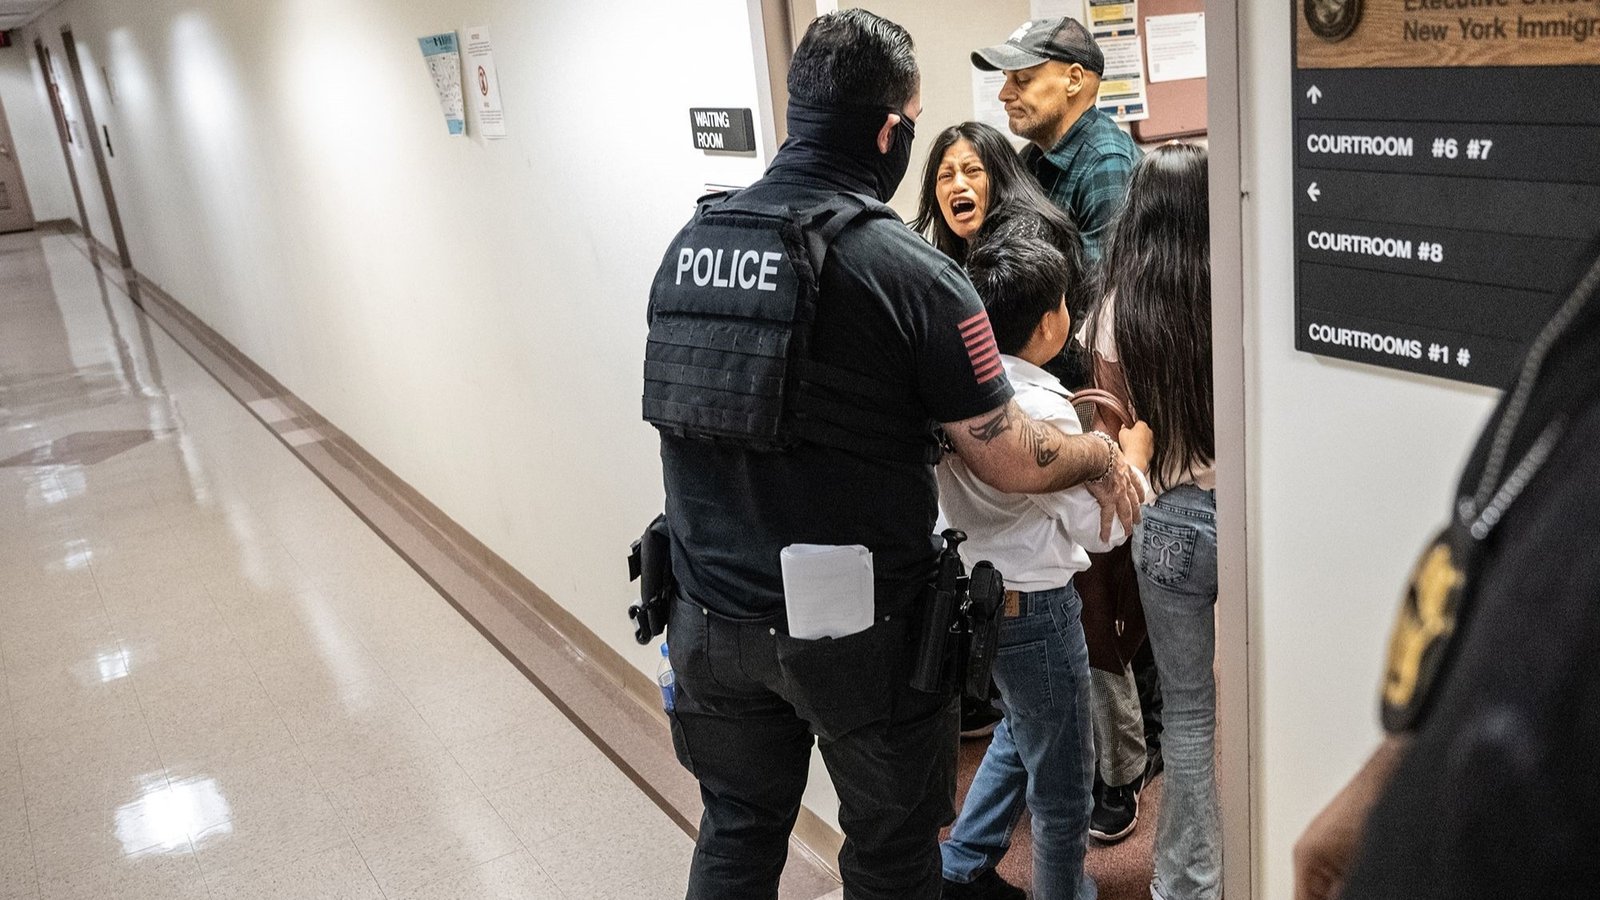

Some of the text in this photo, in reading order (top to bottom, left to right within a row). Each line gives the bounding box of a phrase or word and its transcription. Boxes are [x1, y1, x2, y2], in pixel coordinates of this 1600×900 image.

[1403, 12, 1600, 43] New York Immigr
[694, 111, 730, 128] WAITING
[696, 132, 724, 149] ROOM
[1306, 134, 1493, 161] COURTROOM #6 #7
[1307, 230, 1444, 263] COURTROOM #8
[675, 247, 783, 292] POLICE
[1308, 322, 1423, 360] COURTROOMS
[1427, 342, 1449, 364] #1
